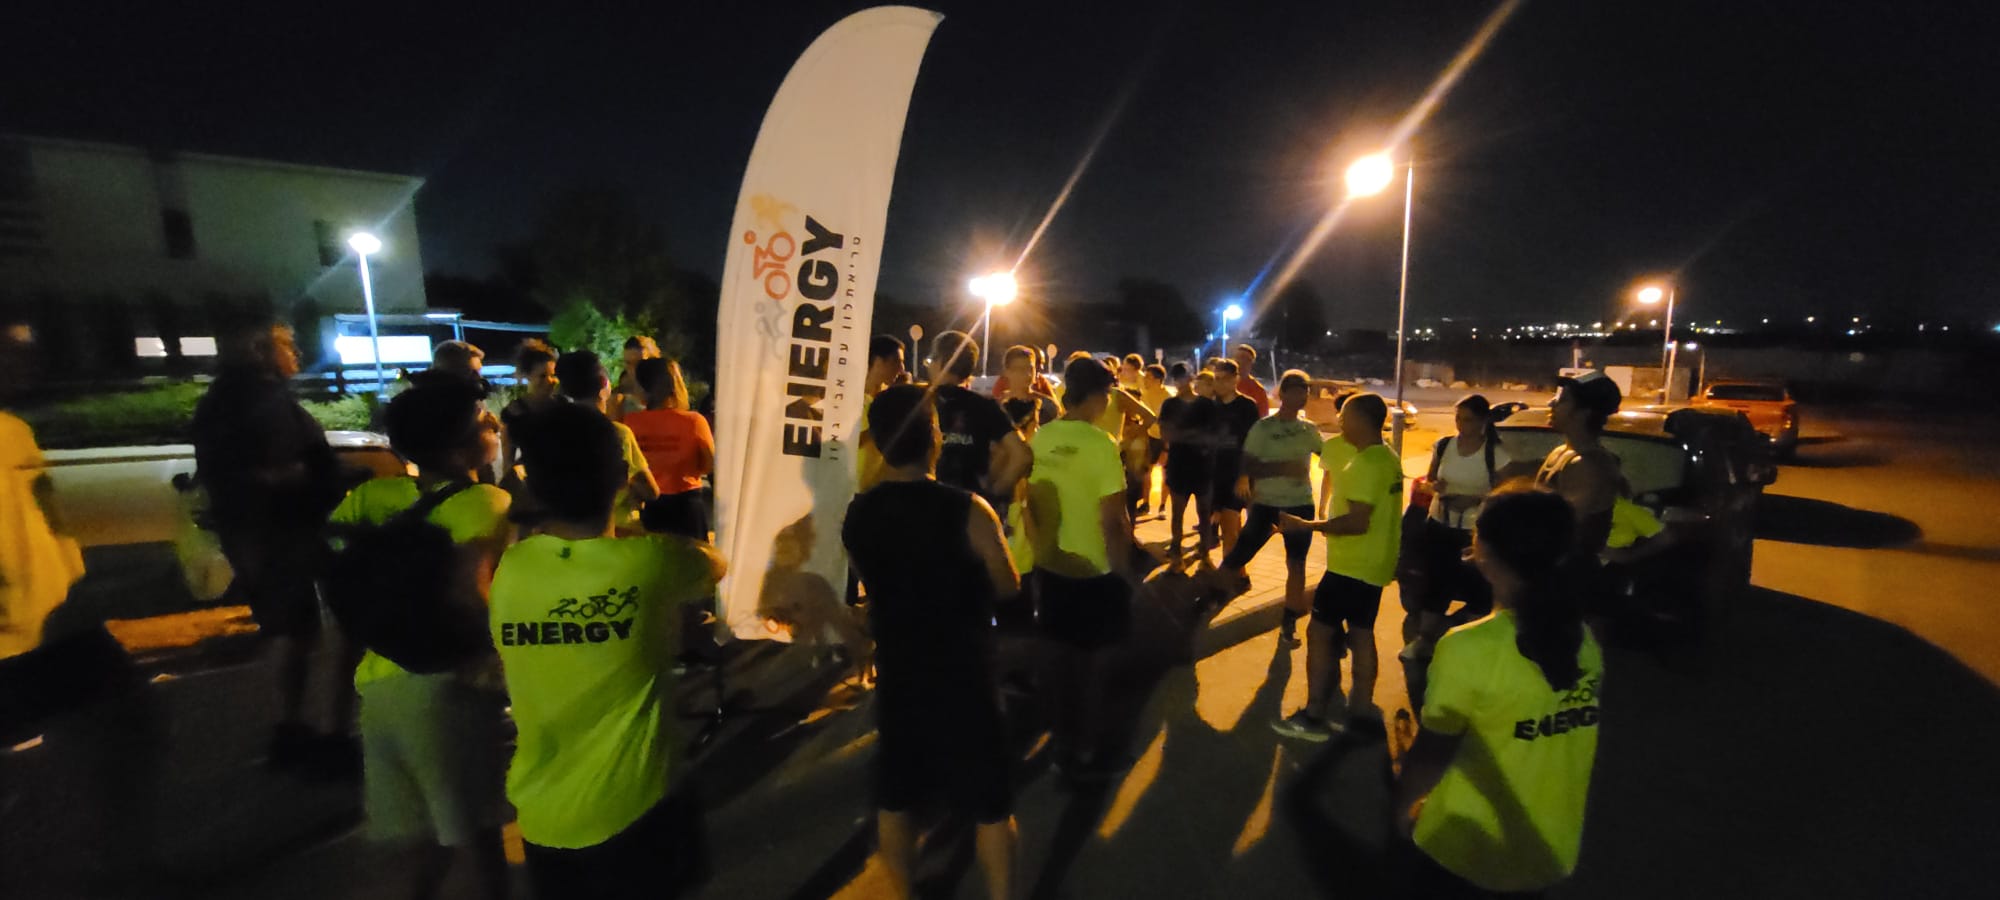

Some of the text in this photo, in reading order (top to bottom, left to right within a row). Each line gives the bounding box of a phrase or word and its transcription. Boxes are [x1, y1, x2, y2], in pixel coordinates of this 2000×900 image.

[843, 236, 861, 330] טריאתלון
[783, 215, 844, 458] ENERGY
[839, 343, 850, 366] עם
[834, 379, 846, 410] אבי
[501, 617, 634, 646] ENERGY
[1514, 706, 1600, 741] ENERG
